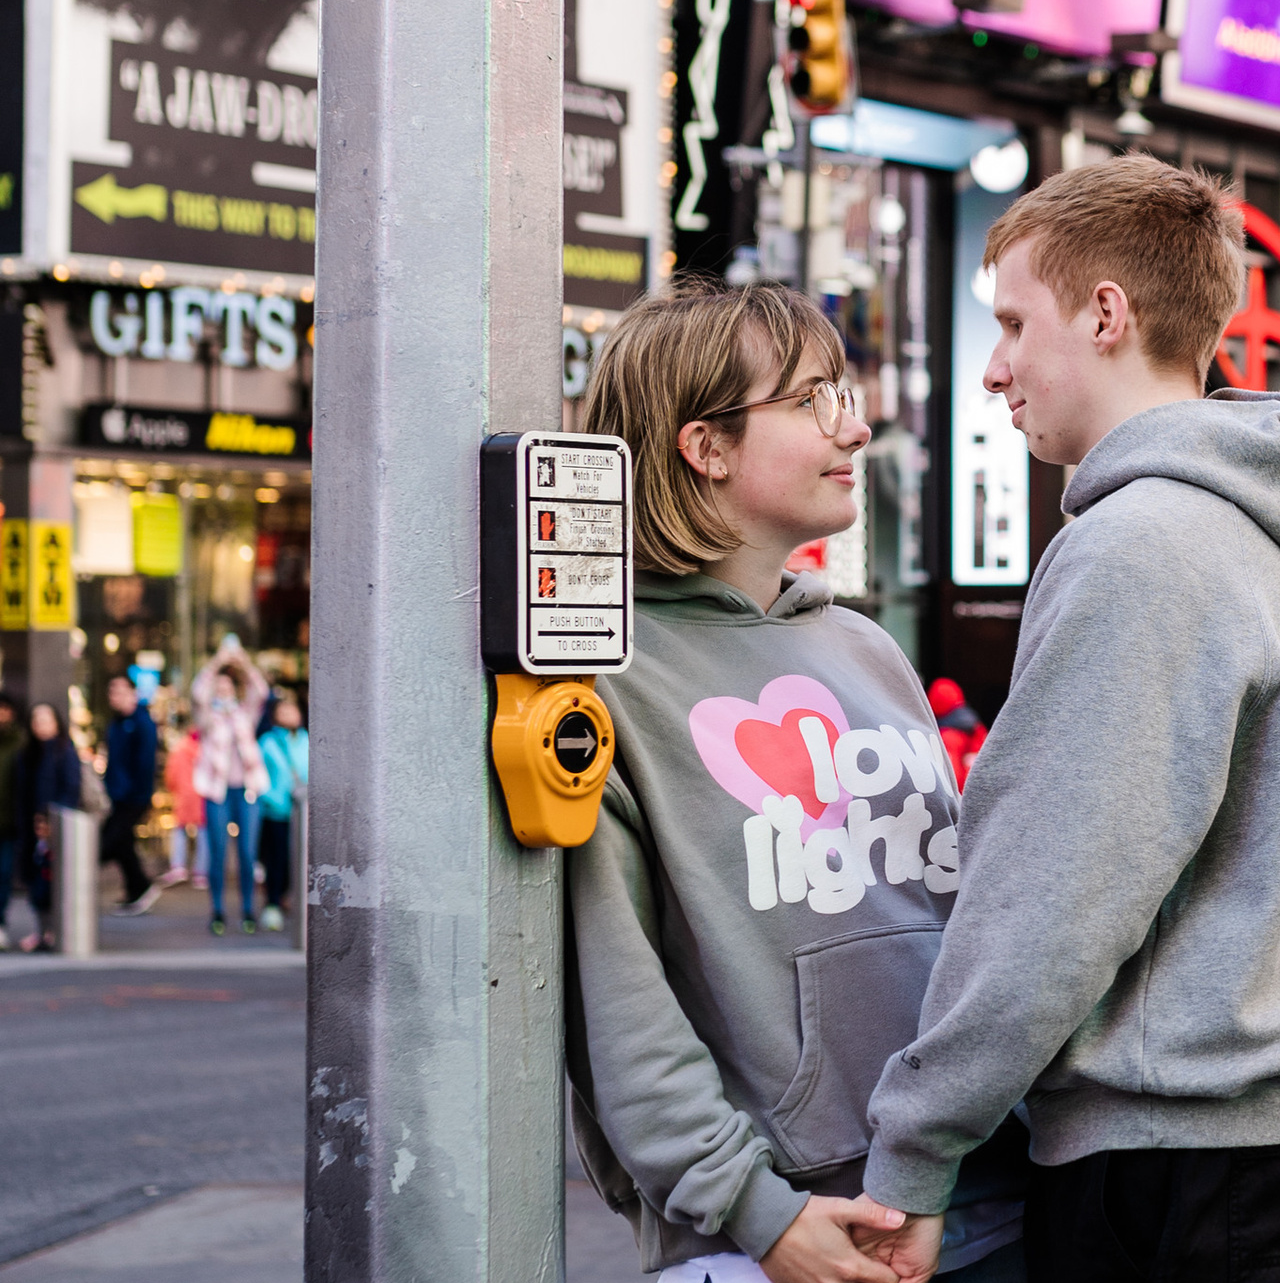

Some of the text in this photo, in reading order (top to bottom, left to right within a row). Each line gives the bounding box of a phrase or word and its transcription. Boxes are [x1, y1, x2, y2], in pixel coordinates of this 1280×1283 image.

[90, 286, 298, 372] GIFTS
[205, 411, 297, 455] Nikon
[561, 453, 614, 467] START CROSSING
[593, 471, 602, 481] For
[576, 484, 599, 494] Vehicles
[590, 575, 611, 586] CROSS
[549, 616, 605, 627] PUSH BUTTON
[557, 640, 598, 651] TO CROSS
[743, 793, 961, 914] lights
